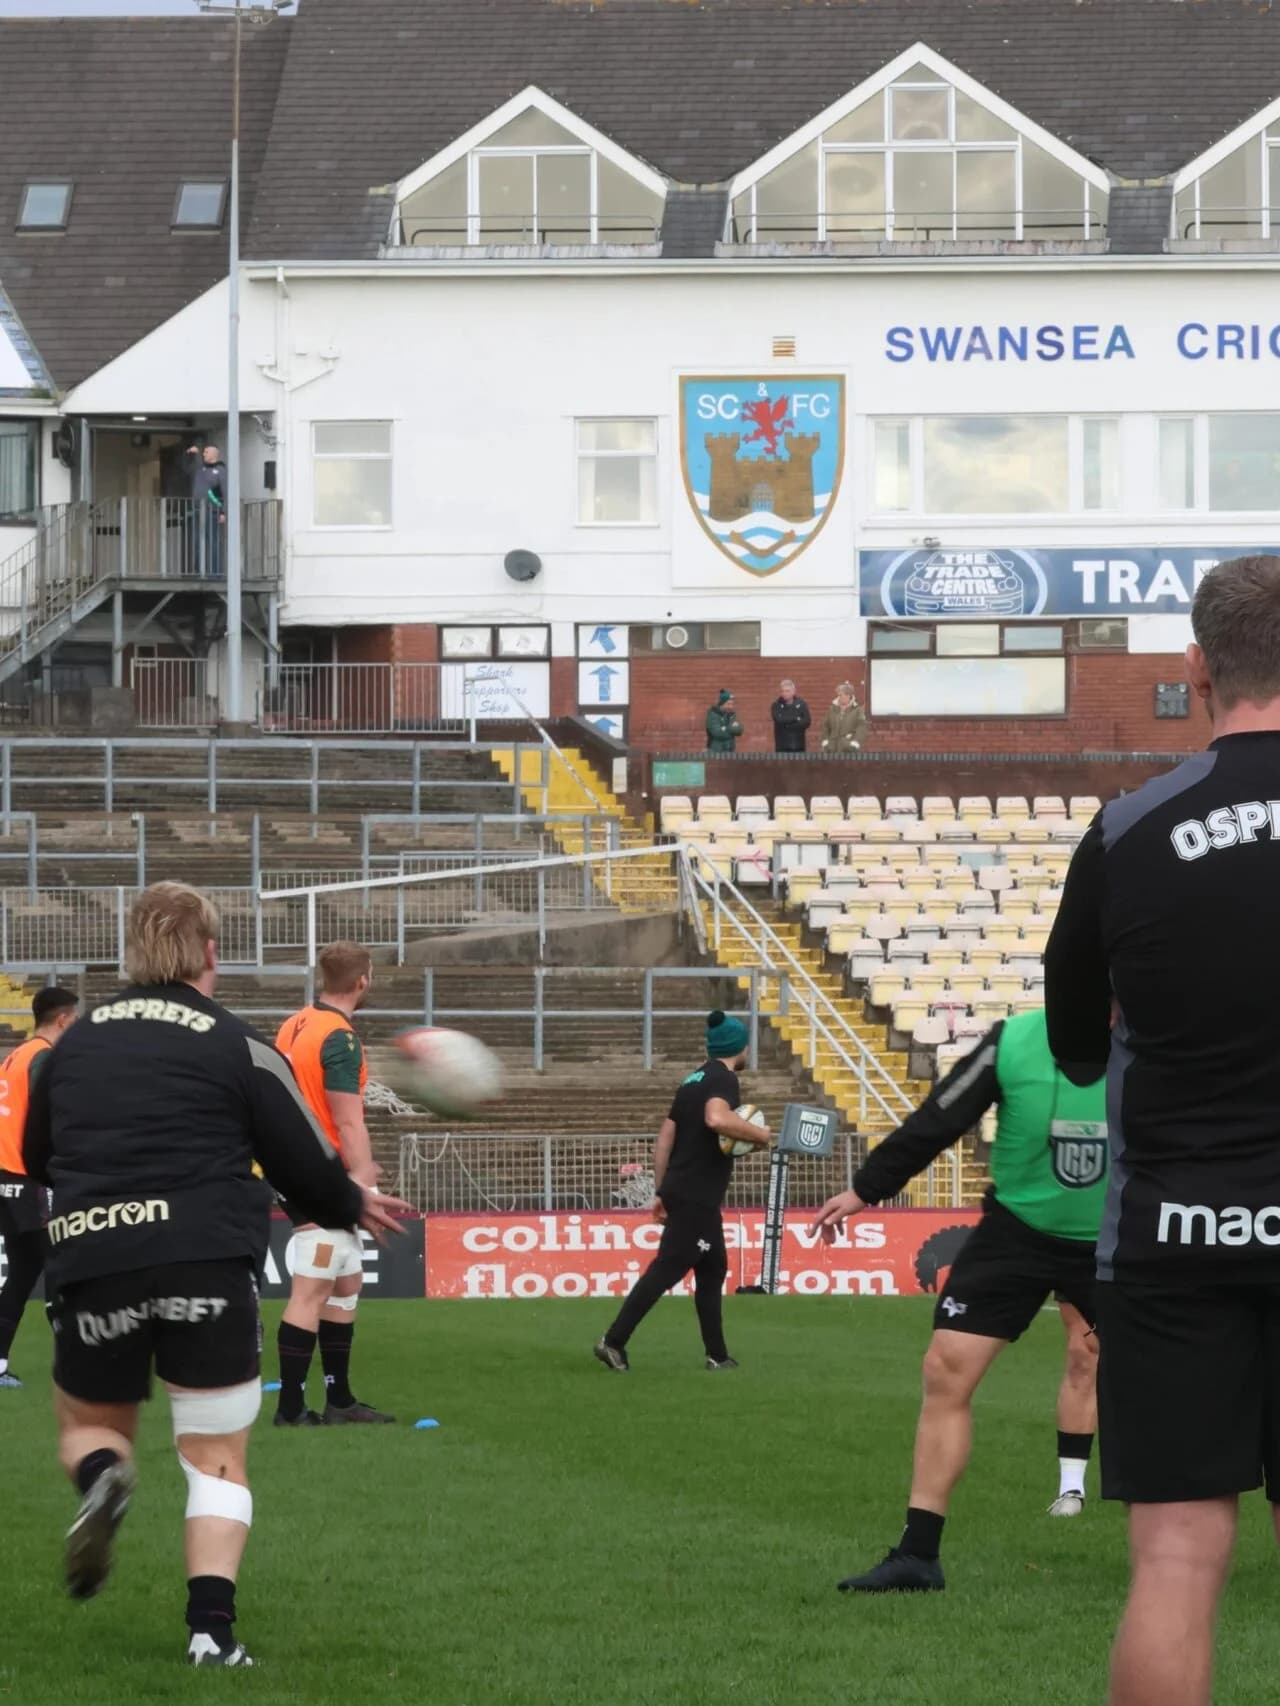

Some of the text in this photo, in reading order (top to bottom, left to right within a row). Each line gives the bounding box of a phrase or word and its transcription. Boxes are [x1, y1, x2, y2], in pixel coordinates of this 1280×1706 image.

[886, 325, 1135, 362] SWANSEA
[757, 382, 768, 397] &
[697, 394, 740, 420] SC
[941, 553, 988, 565] THE
[924, 566, 1006, 578] TRADE
[931, 579, 998, 596] CENTRE
[91, 998, 217, 1032] OSPREYS
[48, 1199, 169, 1246] macron
